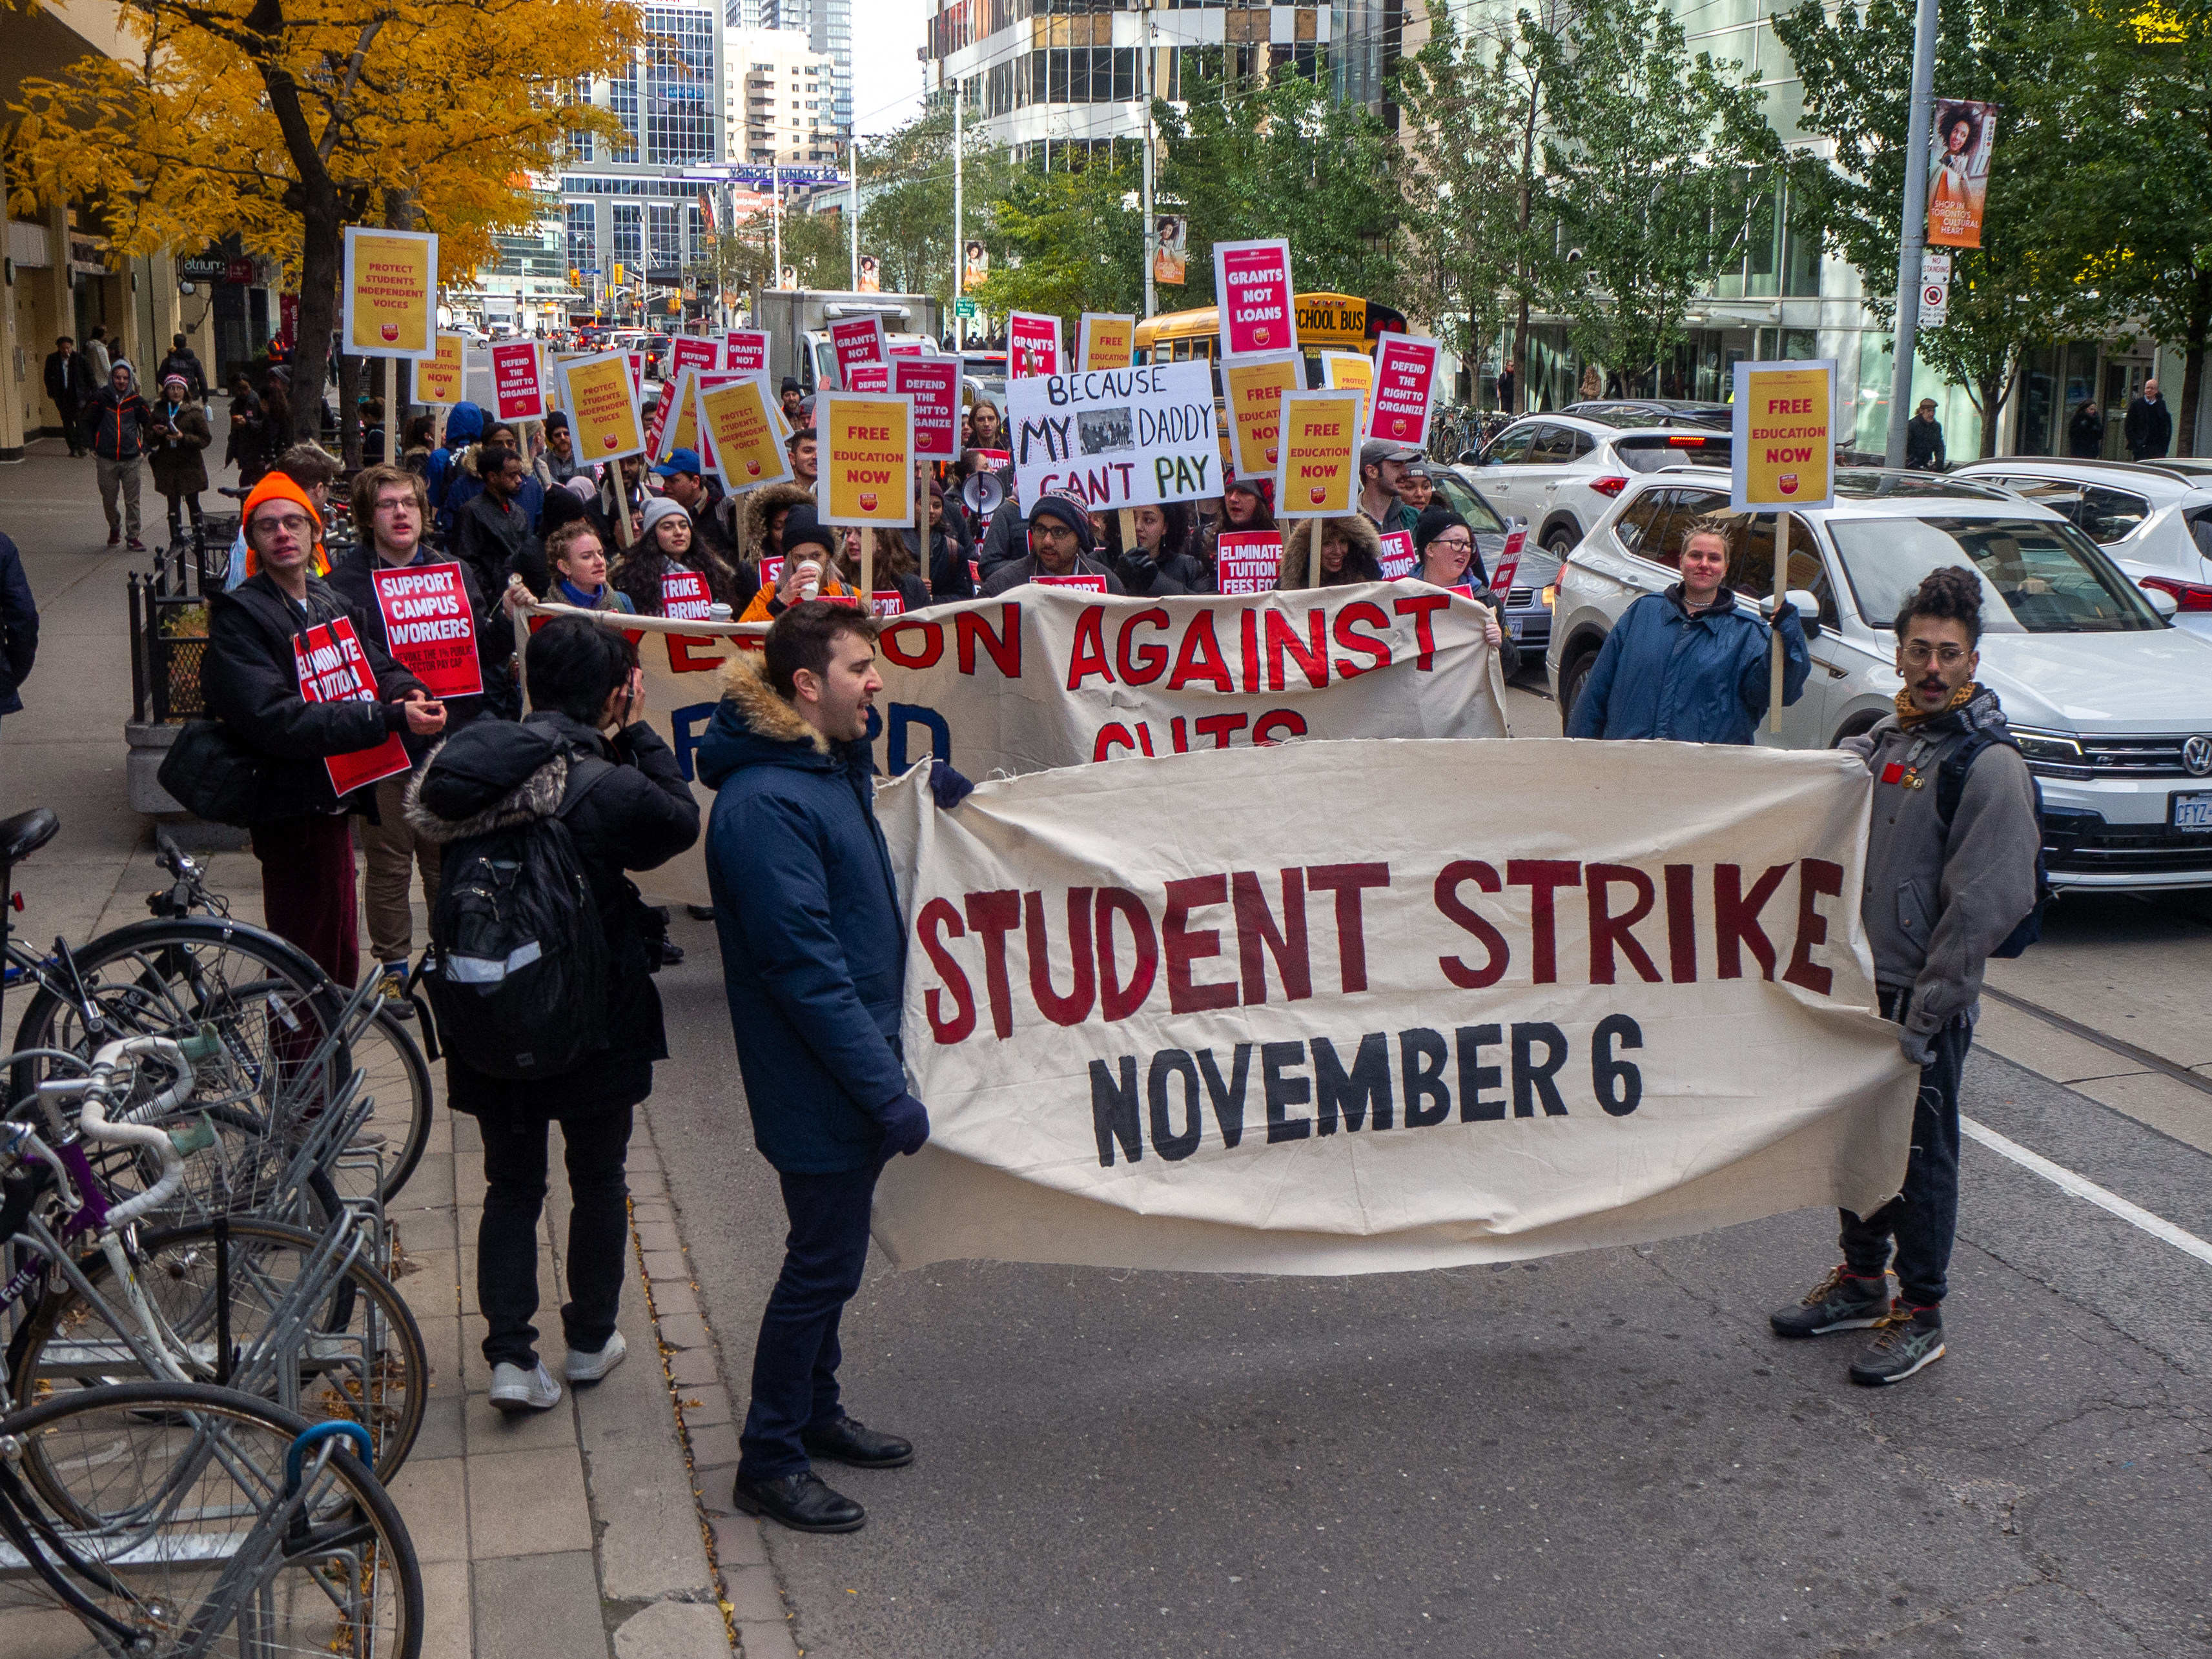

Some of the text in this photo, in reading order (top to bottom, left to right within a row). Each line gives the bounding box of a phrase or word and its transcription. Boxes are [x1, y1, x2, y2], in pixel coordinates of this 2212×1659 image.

[1934, 199, 1955, 209] SHOP
[1941, 226, 1964, 235] HEART
[1943, 218, 1980, 229] CULTURAL
[369, 263, 413, 273] PROTECT
[1228, 268, 1284, 285] GRANTS
[358, 286, 424, 298] INDEPENDENT
[1244, 288, 1273, 303] NOT
[373, 298, 409, 309] VOICES
[1236, 307, 1282, 322] LOANS
[1295, 309, 1364, 331] CHOOL BUS
[837, 333, 877, 348] GRANTS
[1013, 335, 1054, 351] GRANTS
[1100, 336, 1123, 346] FREE
[681, 352, 710, 361] DEFEND
[729, 345, 763, 354] GRANTS
[847, 347, 869, 359] NOT
[1091, 352, 1129, 361] EDUCATION
[500, 358, 529, 367] DEFEND
[736, 356, 755, 365] NOT
[1391, 360, 1426, 374] DEFEND
[427, 374, 453, 382] NOW
[509, 369, 524, 377] THE
[500, 377, 534, 389] RIGHT TO
[583, 381, 617, 396] PROTECT
[857, 381, 887, 390] DEFEND
[906, 380, 947, 390] DEFEND
[1047, 366, 1167, 406] BECAUSE
[1342, 377, 1367, 386] PROTECT
[1398, 376, 1417, 387] THE
[500, 387, 538, 399] ORGANIZE
[916, 392, 936, 403] THE
[1246, 385, 1282, 401] FREE
[1383, 387, 1412, 400] RIGHT
[1411, 391, 1424, 402] TO
[578, 399, 629, 417] INDEPENDENT
[914, 405, 949, 415] GHT TO
[1378, 400, 1425, 416] ORGANIZE
[1768, 398, 1813, 414] FREE
[592, 412, 620, 424] VOICES
[720, 407, 753, 422] PROTECT
[1238, 409, 1281, 422] EDUCAT
[914, 418, 952, 429] GANIZE
[1304, 423, 1340, 436] FREE
[718, 424, 768, 444] INDEPENDENT
[848, 426, 890, 441] FREE
[1019, 403, 1213, 465] MY DADDY
[1752, 426, 1827, 440] EDUCATION
[733, 438, 760, 450] VOICES
[834, 451, 904, 463] EDUCATION
[1291, 447, 1351, 458] EDUCATION
[1766, 447, 1813, 463] NOW
[846, 469, 891, 484] NOW
[1300, 464, 1339, 478] NOW
[1039, 454, 1209, 505] CAN'T PAY
[1220, 544, 1284, 561] ELIMINATE
[1381, 537, 1405, 557] IKE
[1500, 553, 1522, 566] GRANTS
[1228, 561, 1276, 578] TUITION
[1382, 557, 1414, 579] RING
[1497, 569, 1511, 583] NOT
[381, 571, 454, 597] SUPPORT
[662, 578, 702, 599] TRIKE
[1224, 578, 1254, 594] FEES
[391, 595, 460, 620] CAMPUS
[667, 599, 711, 620] BRING
[389, 618, 471, 646] WORKERS
[1066, 593, 1451, 694] AGAINST
[296, 636, 362, 681] ELIMINATE
[423, 648, 436, 659] THE
[436, 658, 449, 671] PAY
[449, 656, 463, 669] CAP
[307, 665, 364, 704] TUITION
[2177, 804, 2207, 823] CFYZ
[916, 857, 1845, 1044] STUDENT STRIKE
[1088, 1013, 1644, 1167] NOVEMBER 6
